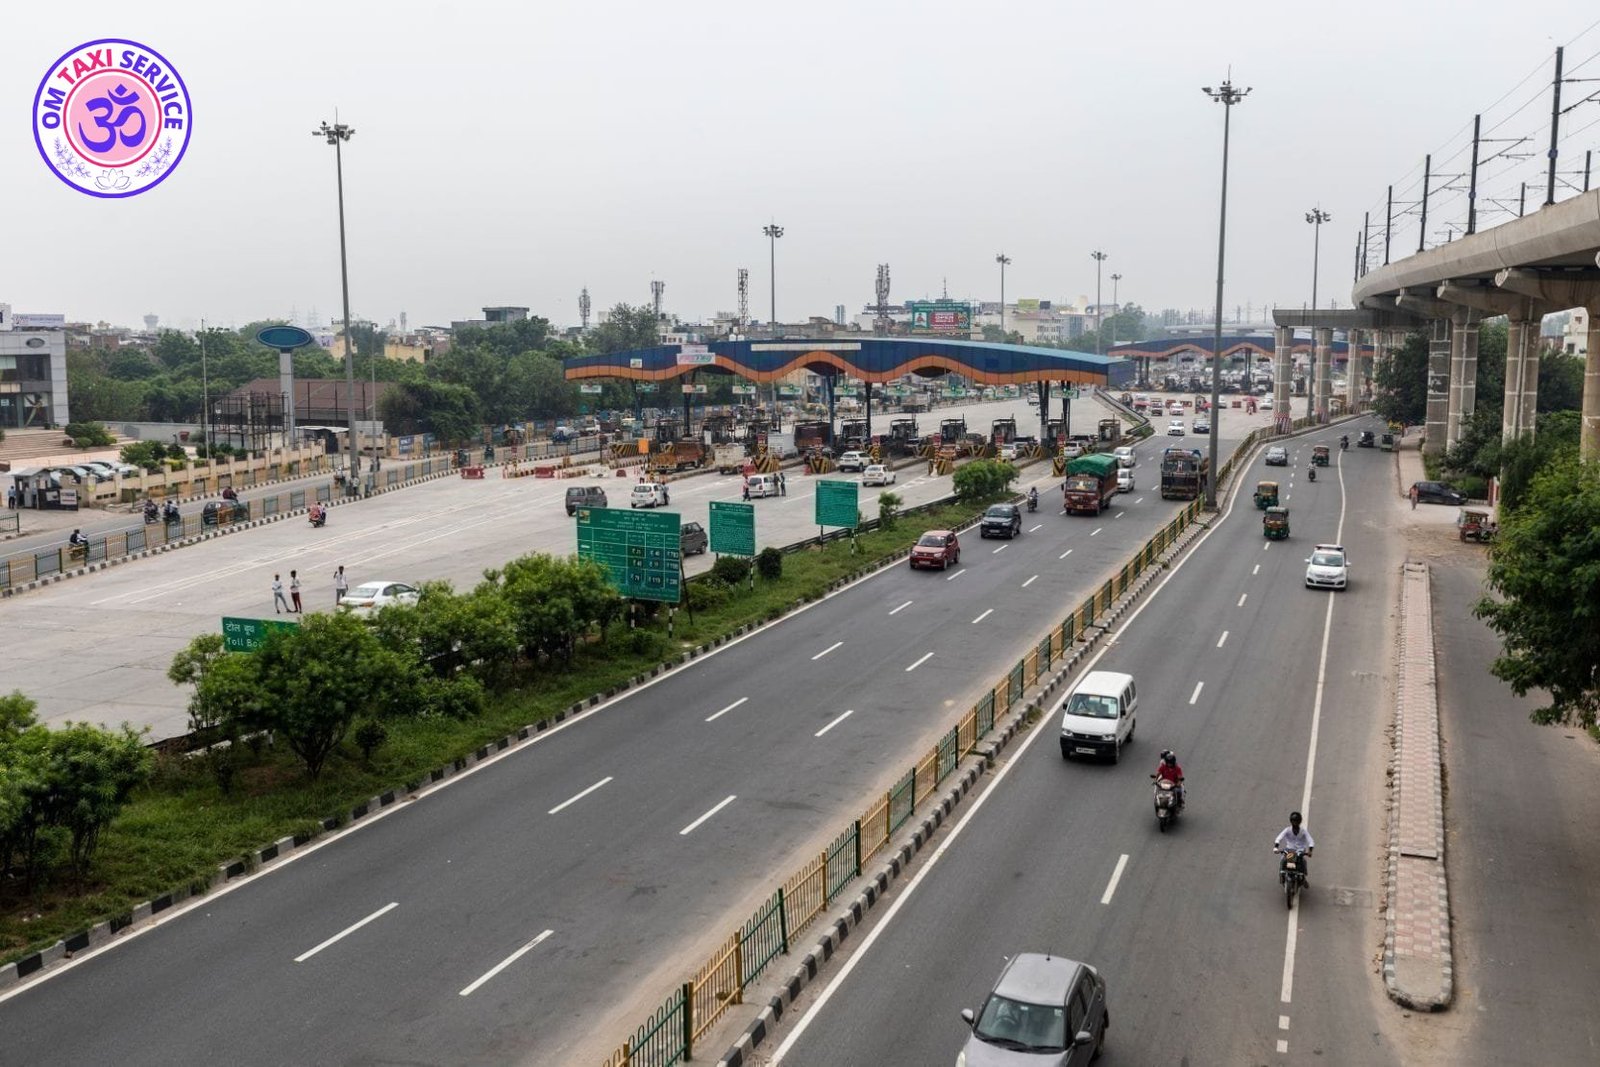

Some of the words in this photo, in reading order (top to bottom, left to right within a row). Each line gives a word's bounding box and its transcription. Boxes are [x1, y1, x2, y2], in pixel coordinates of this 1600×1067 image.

[225, 621, 241, 632] टोल
[226, 637, 244, 646] Toll
[246, 638, 263, 648] Boo
